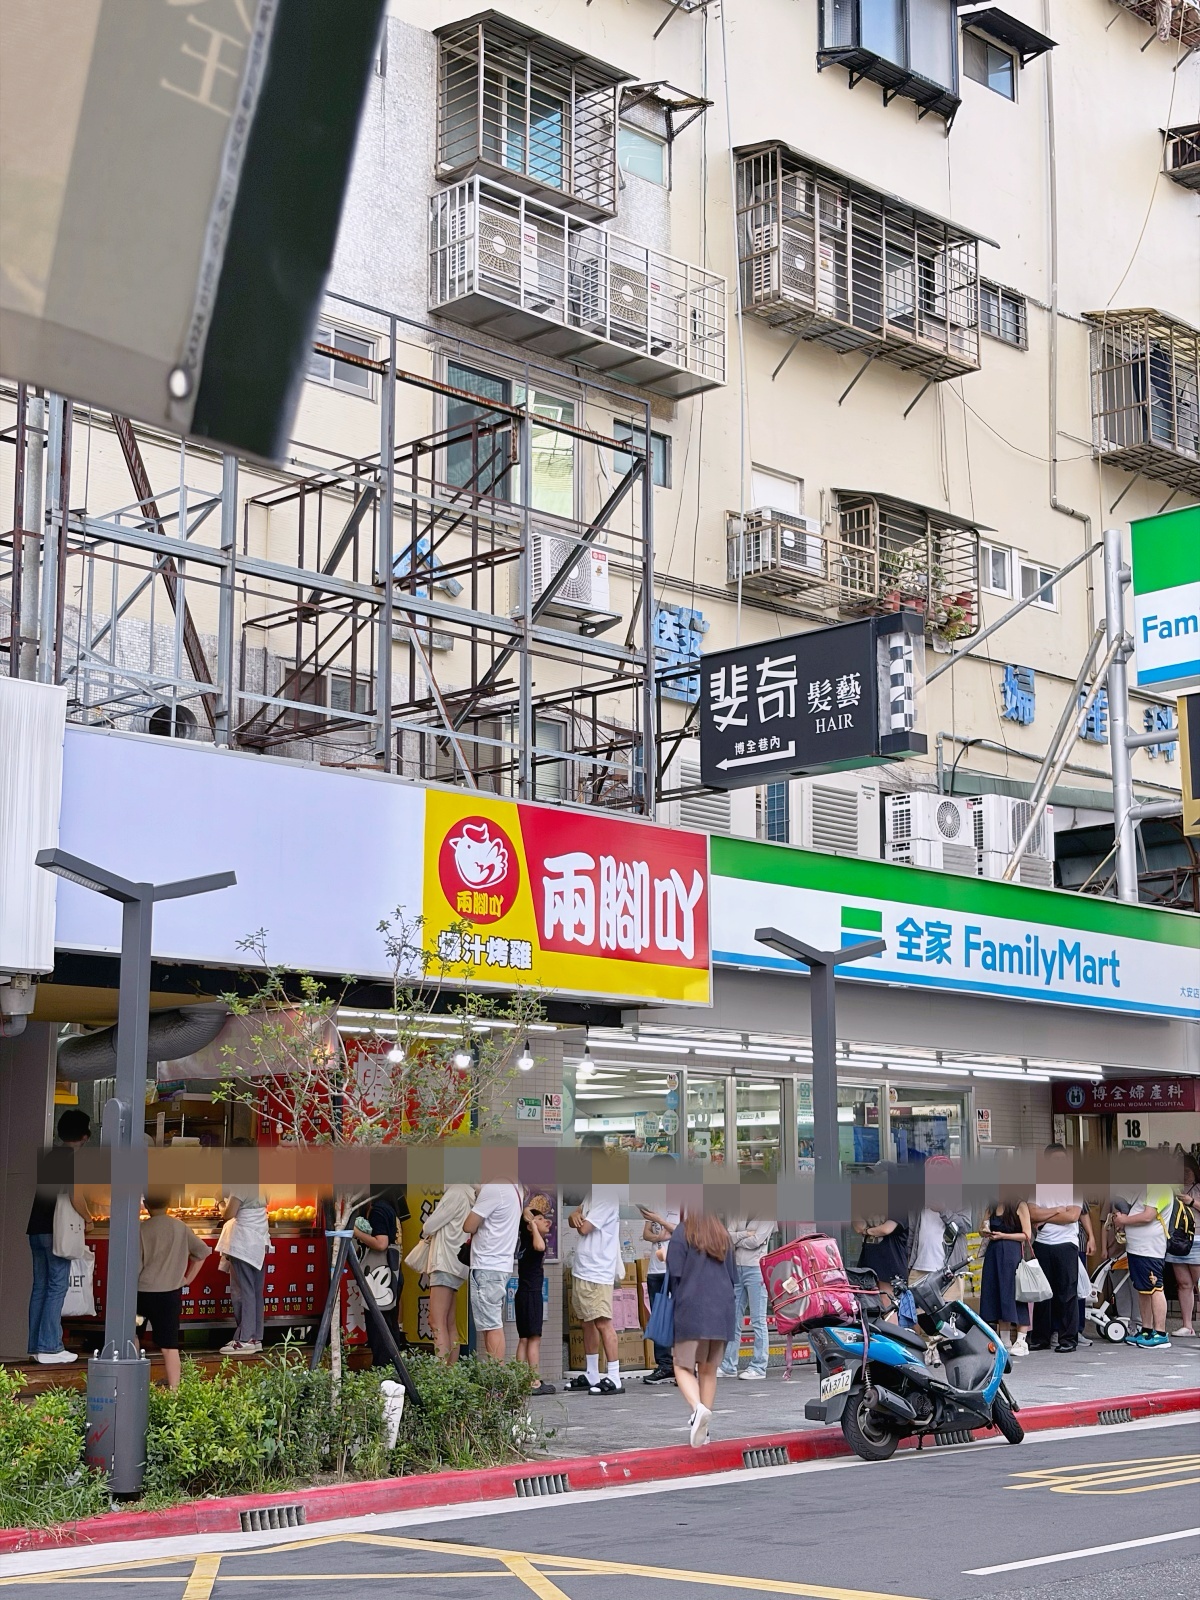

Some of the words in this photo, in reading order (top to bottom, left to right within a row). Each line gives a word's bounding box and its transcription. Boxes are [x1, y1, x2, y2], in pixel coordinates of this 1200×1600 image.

[1142, 614, 1199, 643] Fam
[710, 655, 798, 732] 斐奇
[807, 672, 862, 714] 髮藝
[815, 714, 854, 734] HAIR
[734, 735, 781, 755] 博全巷內
[896, 917, 952, 965] 全家
[964, 926, 1121, 988] FamilyMart
[1092, 1083, 1184, 1101] 博全婦產科
[527, 1107, 536, 1118] 20
[1125, 1119, 1141, 1138] 18
